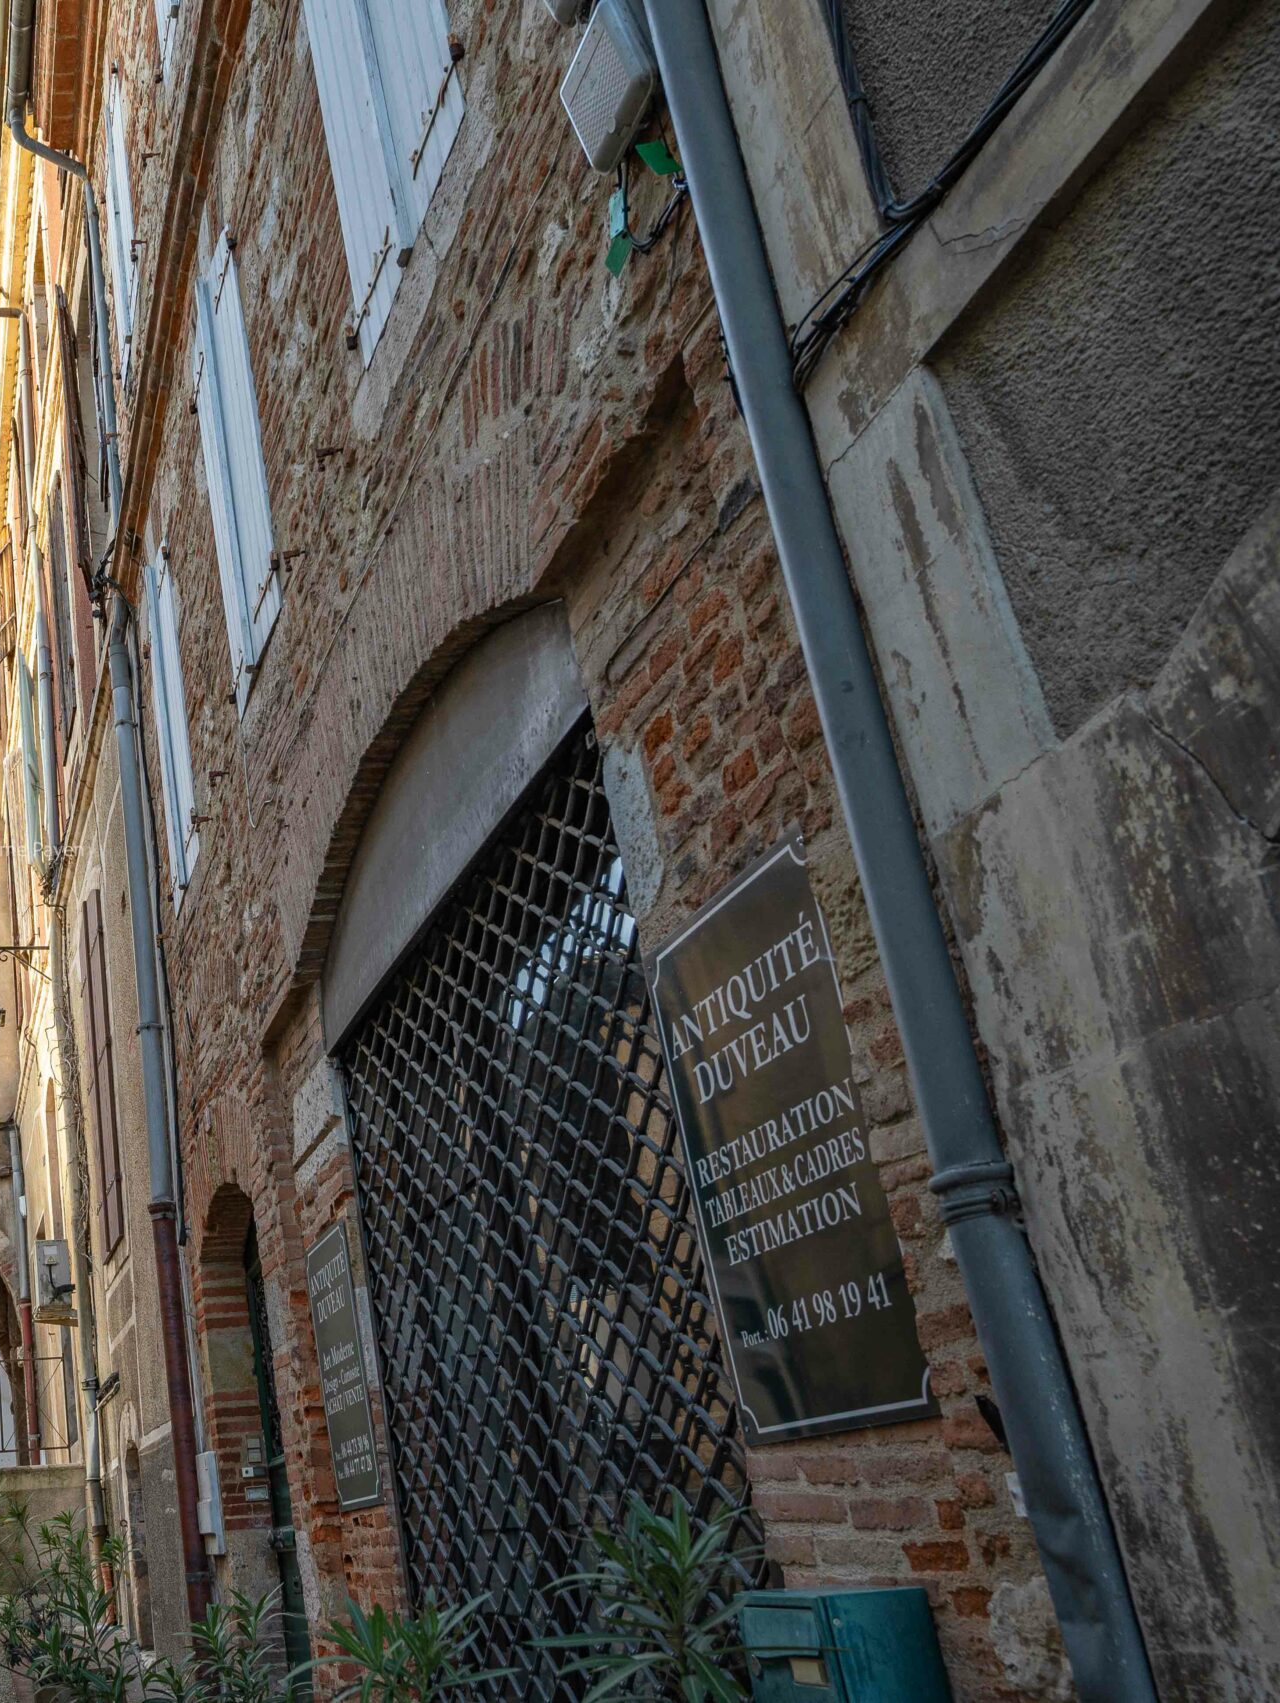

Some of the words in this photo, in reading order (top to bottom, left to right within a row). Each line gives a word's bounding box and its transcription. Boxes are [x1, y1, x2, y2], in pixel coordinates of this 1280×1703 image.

[673, 911, 819, 1061] ANTIQUITÉ
[693, 994, 810, 1104] DUVEAU
[696, 1078, 855, 1188] RESTAURATION
[724, 1181, 862, 1266] ESTIMATION
[311, 1245, 346, 1298] ANTIQUITÉ
[317, 1284, 346, 1324] DUVEAU
[767, 1304, 789, 1340] 06
[792, 1297, 812, 1332] 41
[812, 1289, 837, 1327] 98
[838, 1281, 861, 1318] 19
[867, 1271, 893, 1311] 41
[330, 1341, 355, 1367] Moderne
